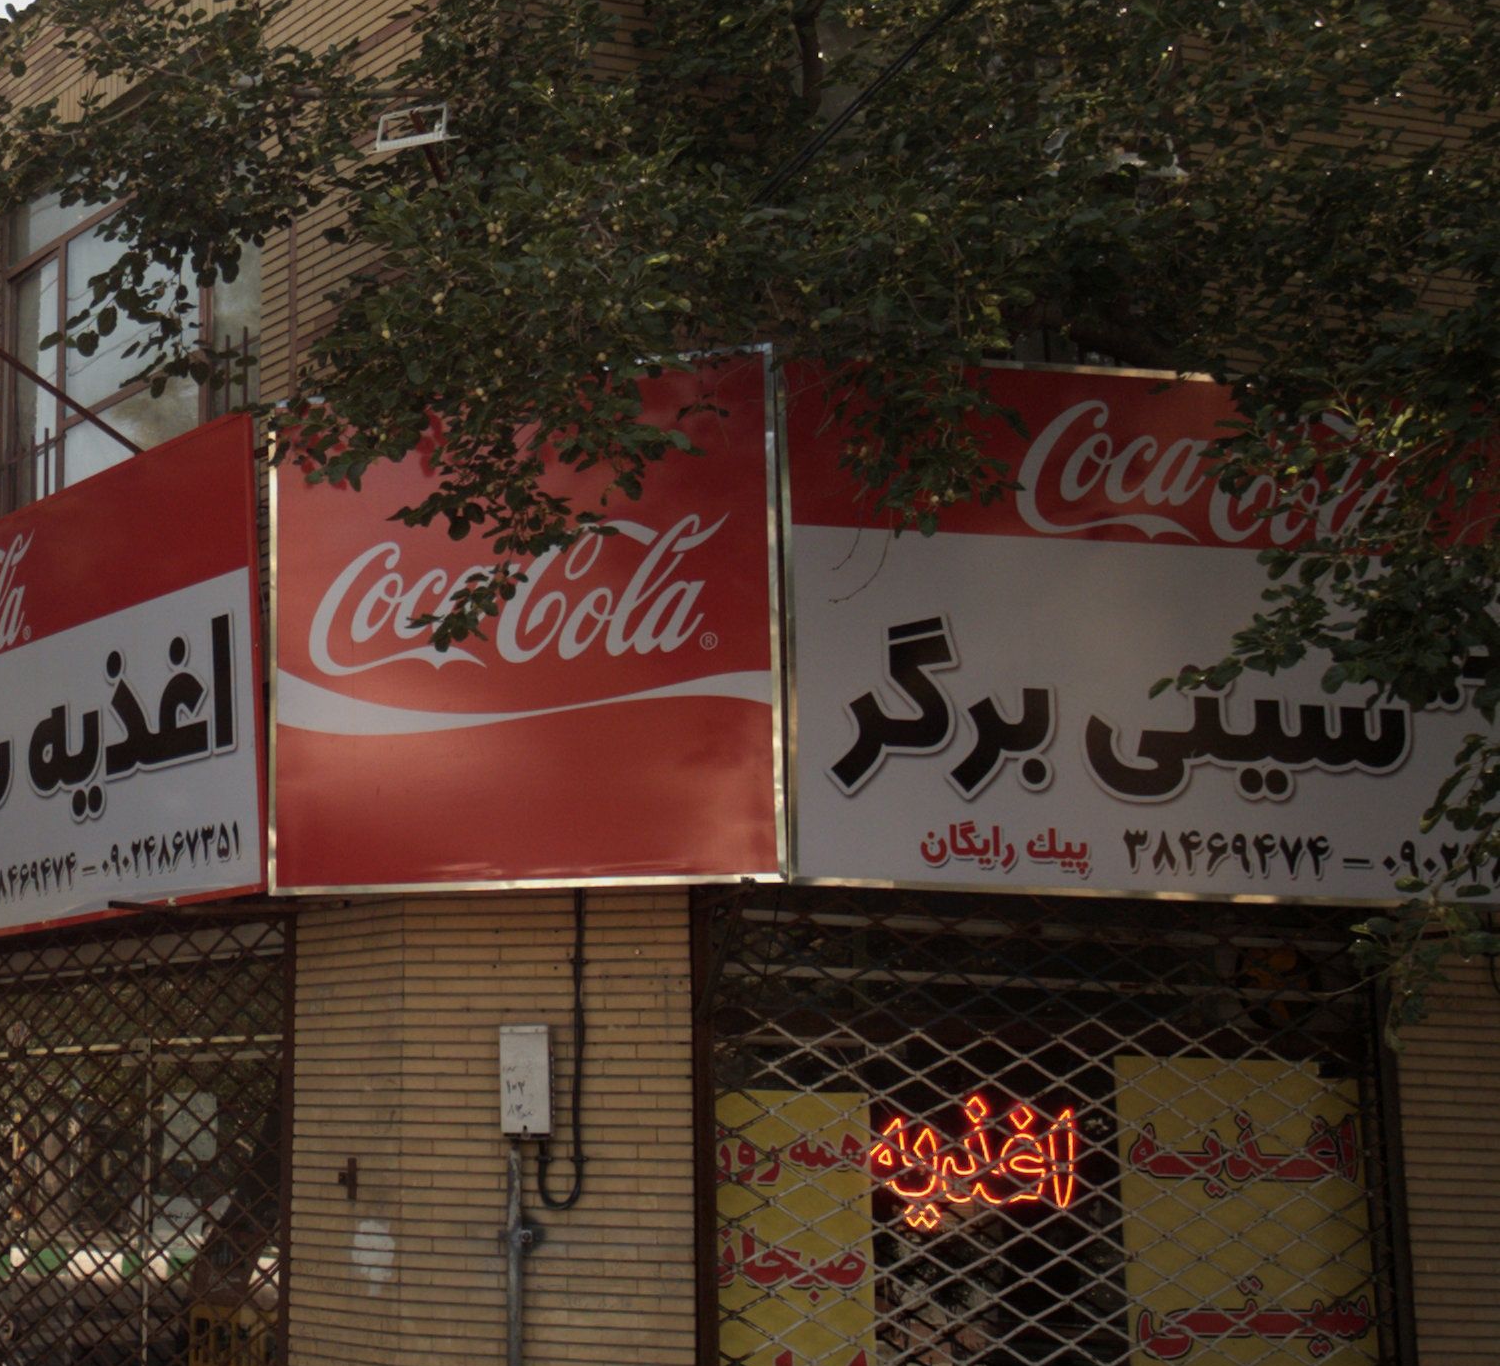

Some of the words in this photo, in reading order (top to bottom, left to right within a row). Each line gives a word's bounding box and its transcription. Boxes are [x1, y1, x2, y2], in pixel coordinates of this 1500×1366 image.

[29, 611, 236, 821] اغذیه
[830, 616, 1053, 795] برگر
[1085, 664, 1406, 801] سیتی
[920, 820, 1015, 868] رایگان
[1123, 828, 1331, 876] ۳۸۴۶۹۴۷۴
[788, 1133, 868, 1169] همه
[871, 1096, 1075, 1229] اغذیه
[1129, 1110, 1358, 1197] اغذیه
[717, 1225, 867, 1302] صبحان
[1138, 1276, 1370, 1360] سیتی
